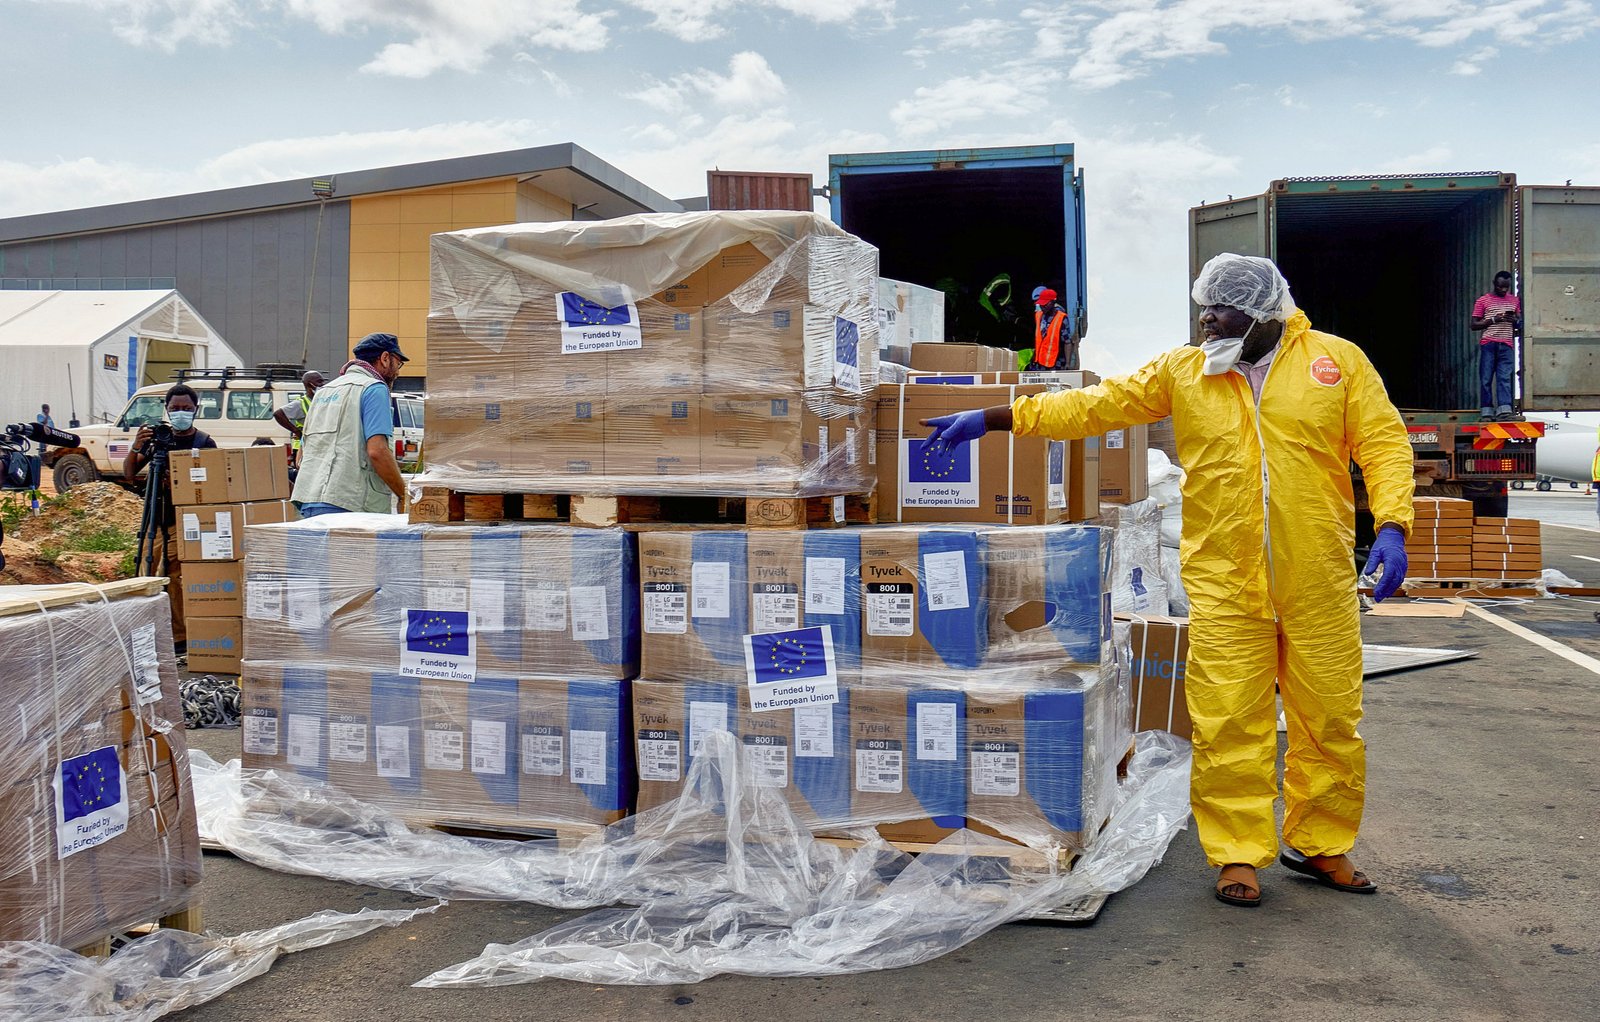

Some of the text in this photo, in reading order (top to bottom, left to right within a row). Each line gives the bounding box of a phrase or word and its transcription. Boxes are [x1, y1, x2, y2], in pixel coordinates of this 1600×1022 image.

[582, 330, 621, 340] Funded by
[579, 341, 614, 350] European
[616, 339, 638, 347] Union
[52, 430, 74, 440] REUTERS
[950, 488, 960, 497] by
[918, 498, 952, 506] European
[418, 503, 441, 516] EPAL
[762, 503, 787, 516] EPAL
[646, 566, 678, 578] Tyvek
[756, 566, 788, 578] Tyvek
[870, 566, 902, 578] Tyvek
[186, 580, 220, 592] unicef
[880, 584, 895, 592] 800
[420, 658, 458, 670] Funded by
[1130, 652, 1186, 680] nice
[416, 668, 449, 678] European
[451, 671, 472, 680] Union
[772, 684, 816, 696] Funded by
[770, 697, 808, 707] European
[810, 694, 834, 702] Union
[640, 713, 669, 725] Tyvek
[858, 722, 890, 734] Tyvek
[975, 724, 1008, 735] Tyvek
[77, 816, 110, 834] Funed by
[62, 842, 72, 854] the
[105, 823, 124, 836] Union
